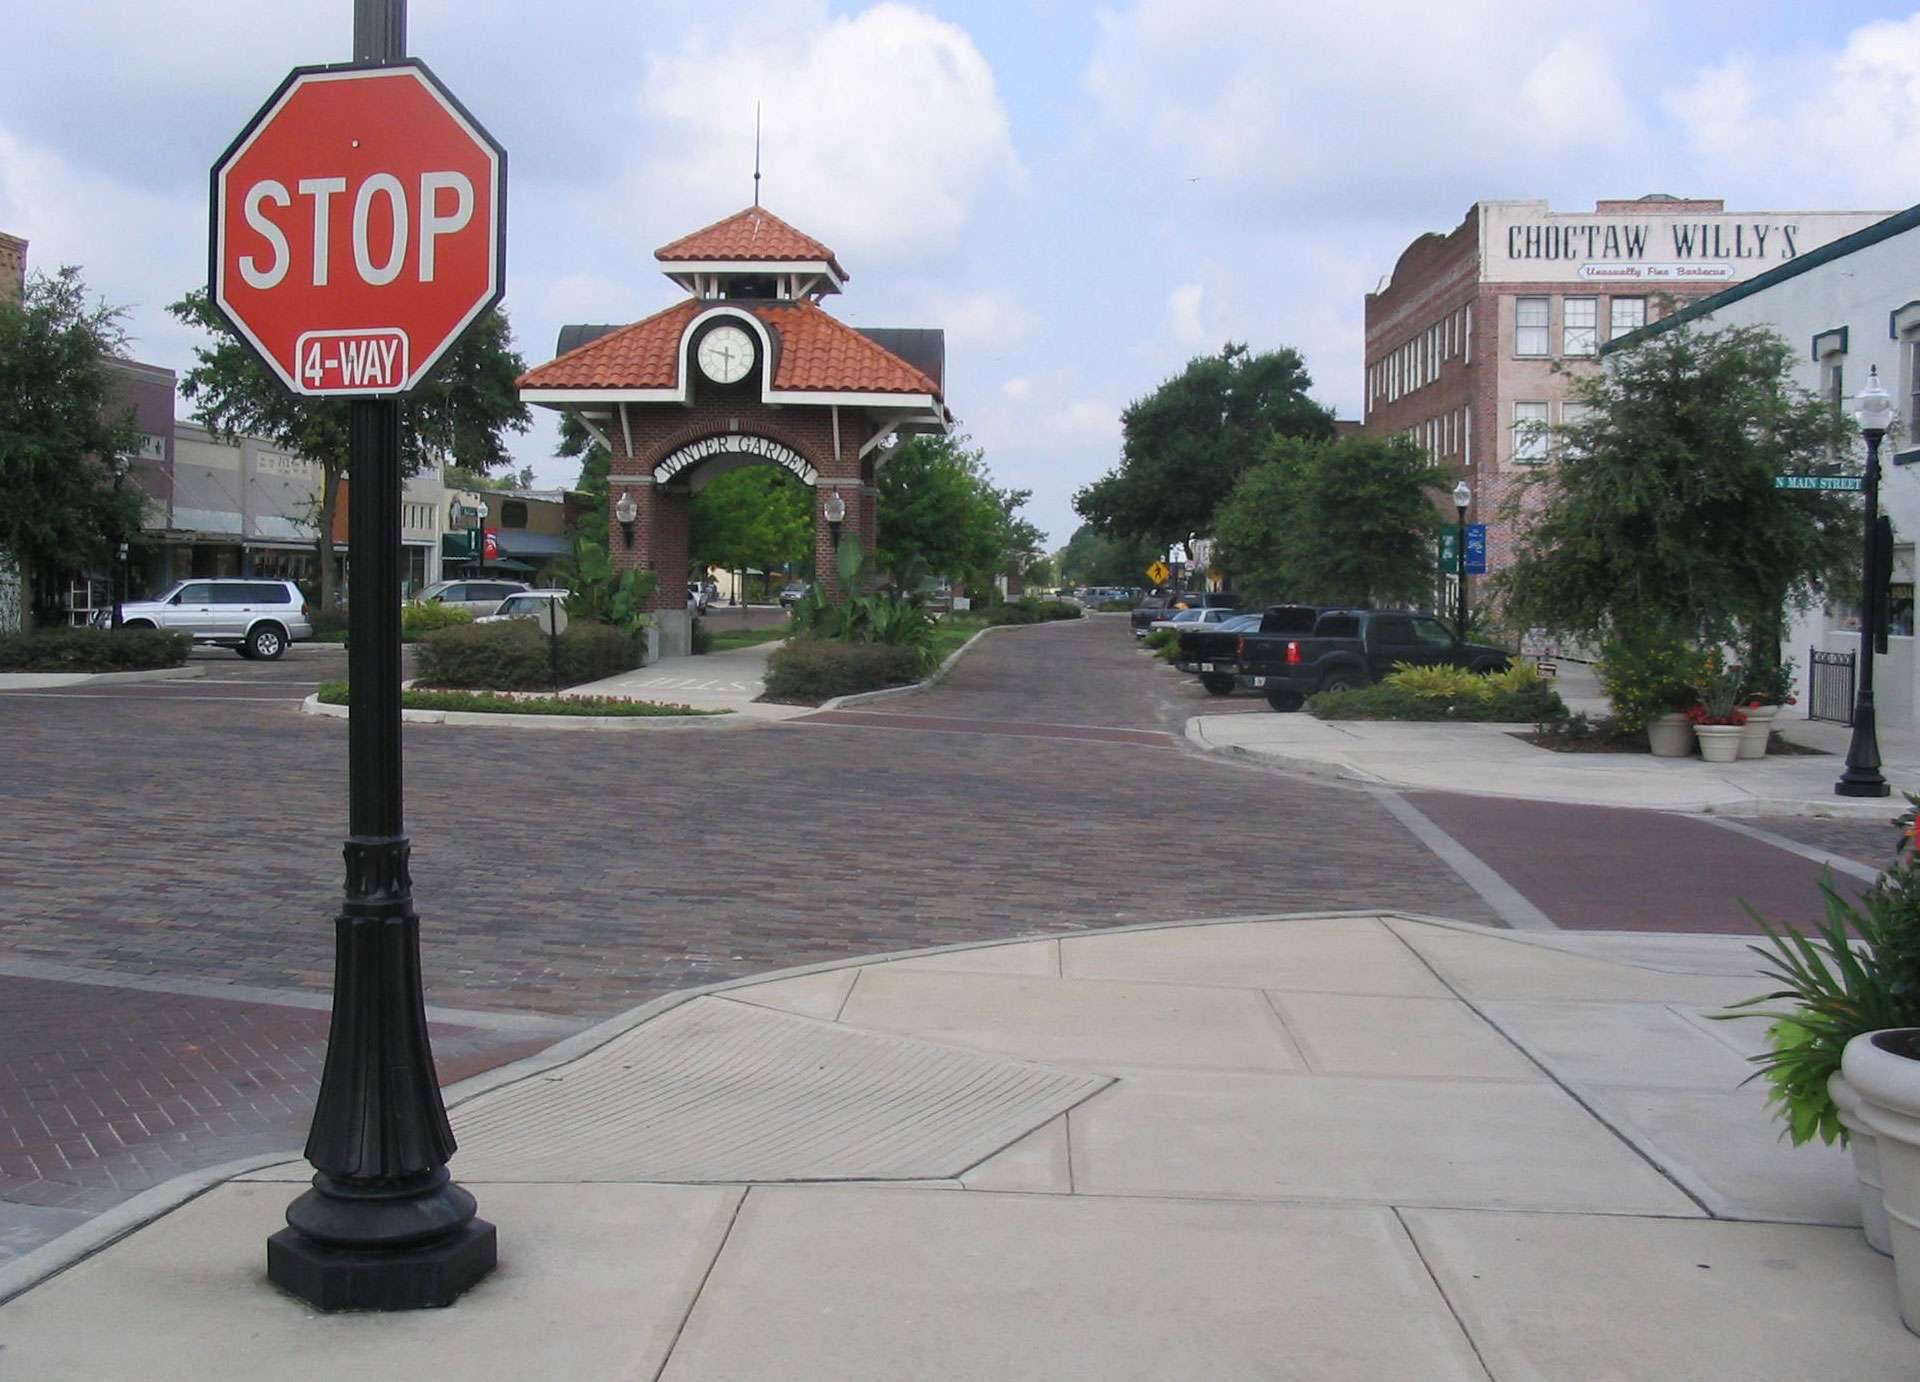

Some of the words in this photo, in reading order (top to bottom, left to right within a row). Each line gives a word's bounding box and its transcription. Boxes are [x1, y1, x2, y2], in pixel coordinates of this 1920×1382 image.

[239, 171, 475, 289] STOP
[1508, 225, 1648, 260] CHOCTAW
[1672, 223, 1798, 260] WILLY'S
[1647, 266, 1669, 276] Fine
[1676, 266, 1726, 276] Barbecue
[304, 338, 399, 387] 4-WAY
[660, 436, 729, 476] WINTER
[738, 436, 813, 480] GARDEN
[1775, 477, 1785, 488] N
[1787, 477, 1818, 489] MAIN
[1820, 478, 1862, 490] STREET
